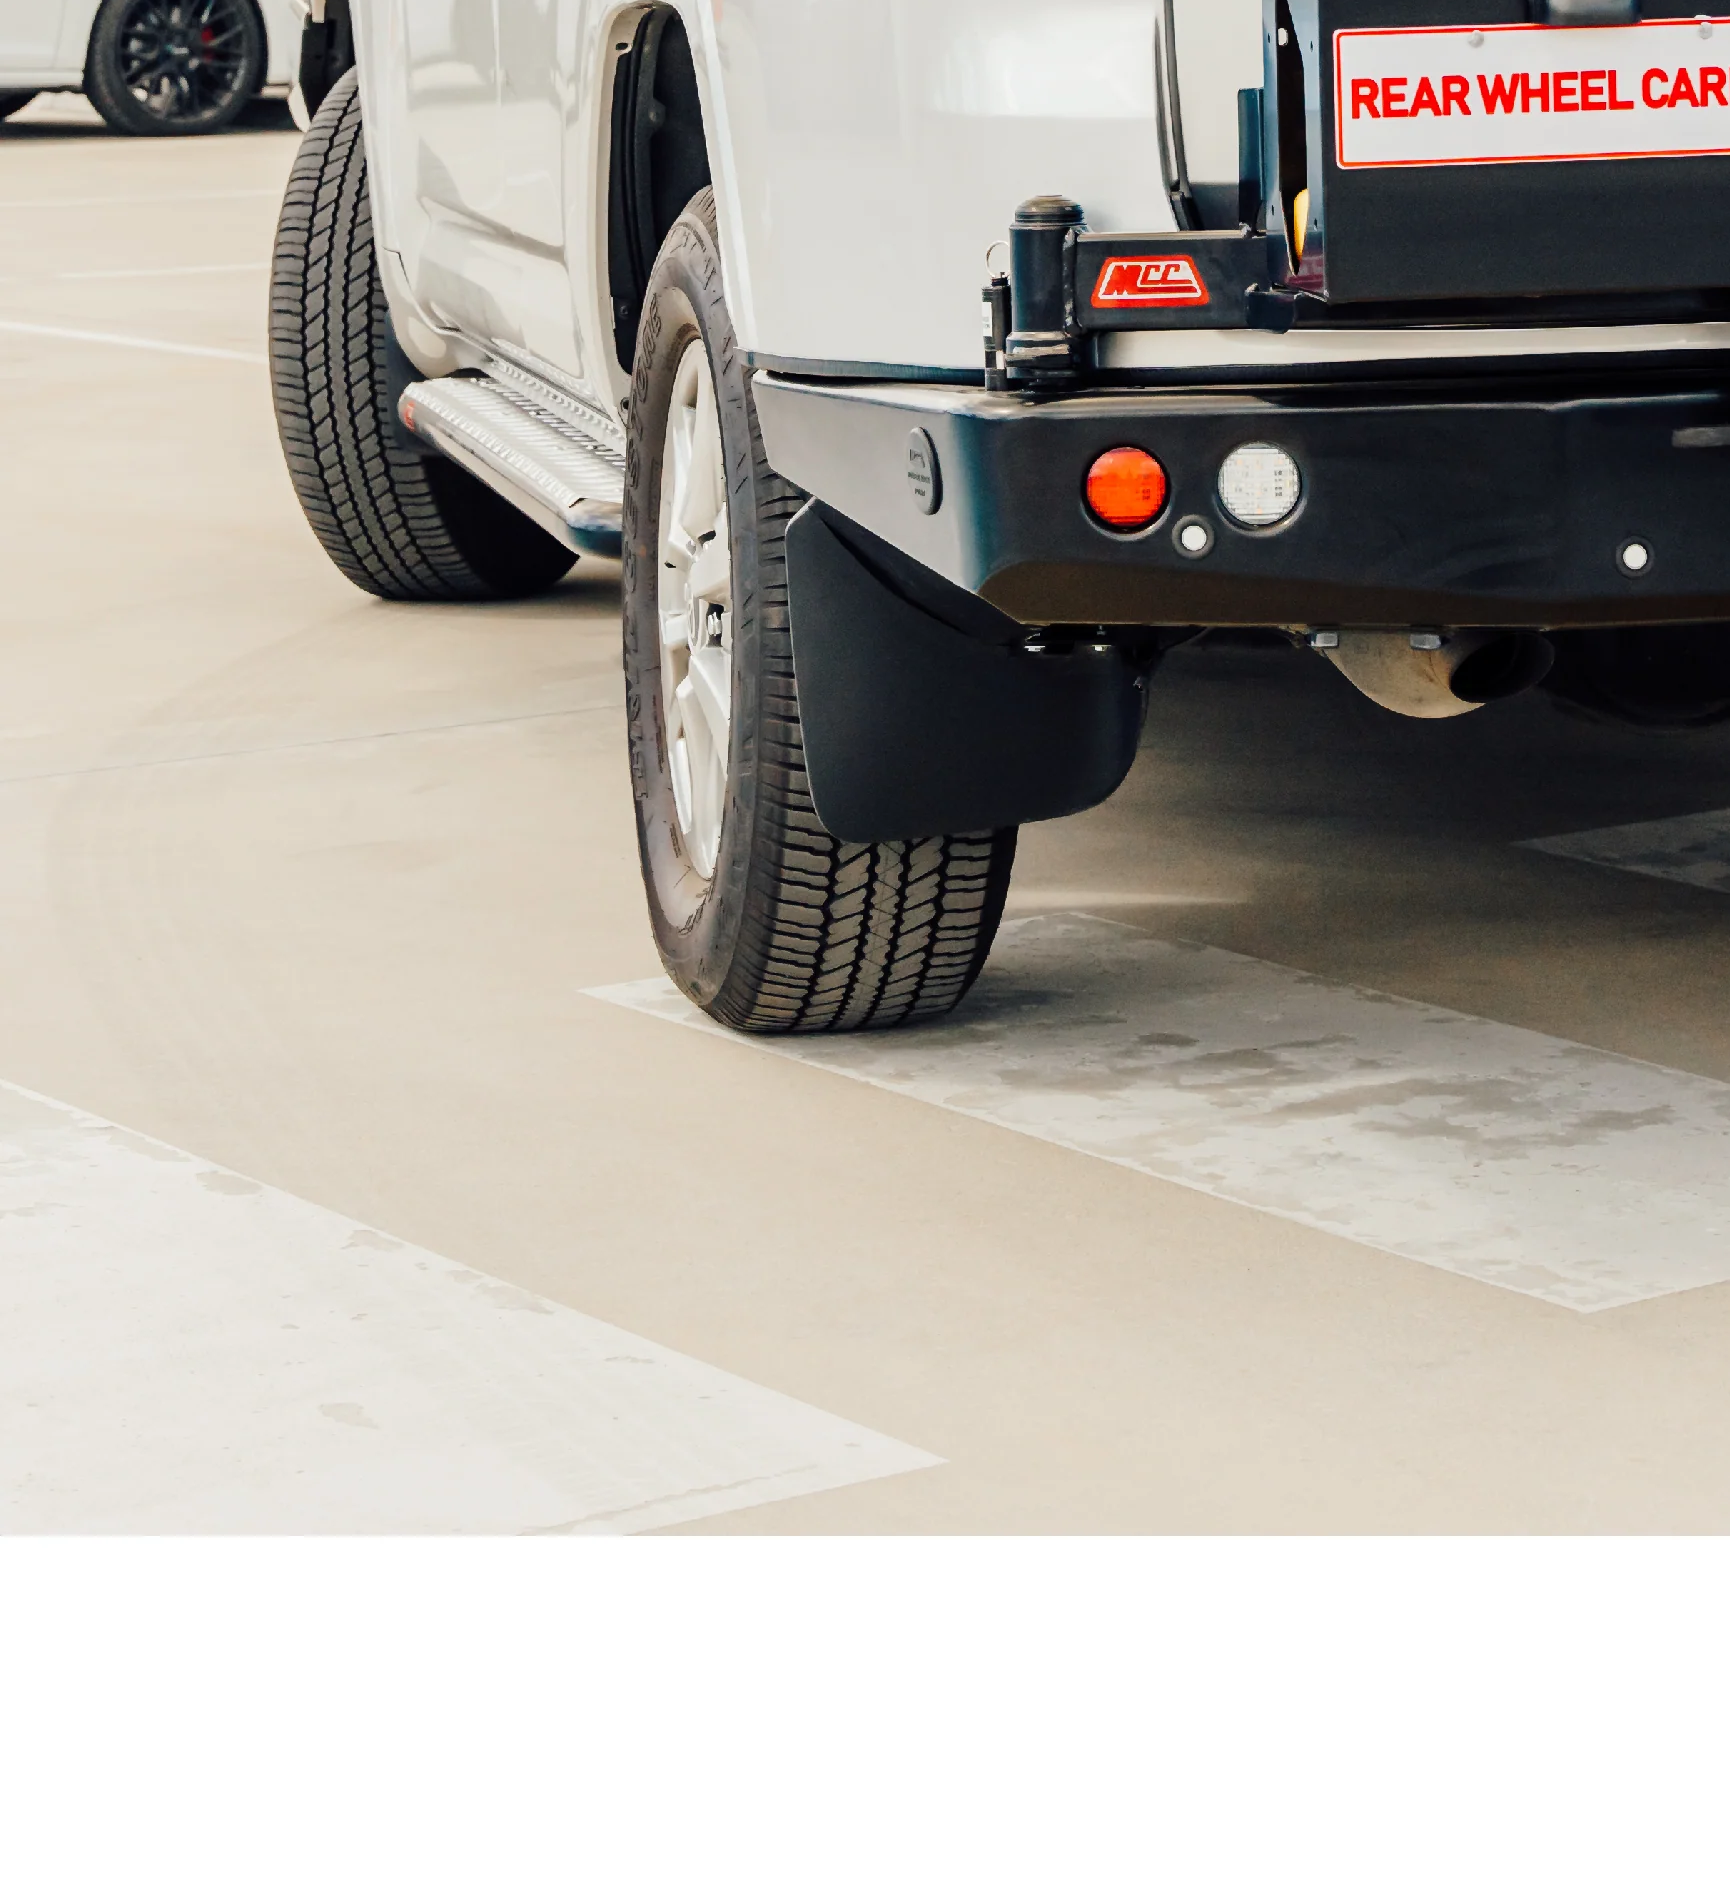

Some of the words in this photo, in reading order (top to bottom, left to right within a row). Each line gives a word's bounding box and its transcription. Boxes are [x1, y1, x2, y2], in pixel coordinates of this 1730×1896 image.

[1350, 74, 1472, 120] REAR
[1476, 69, 1635, 114] WHEEL
[1102, 264, 1193, 295] MCC
